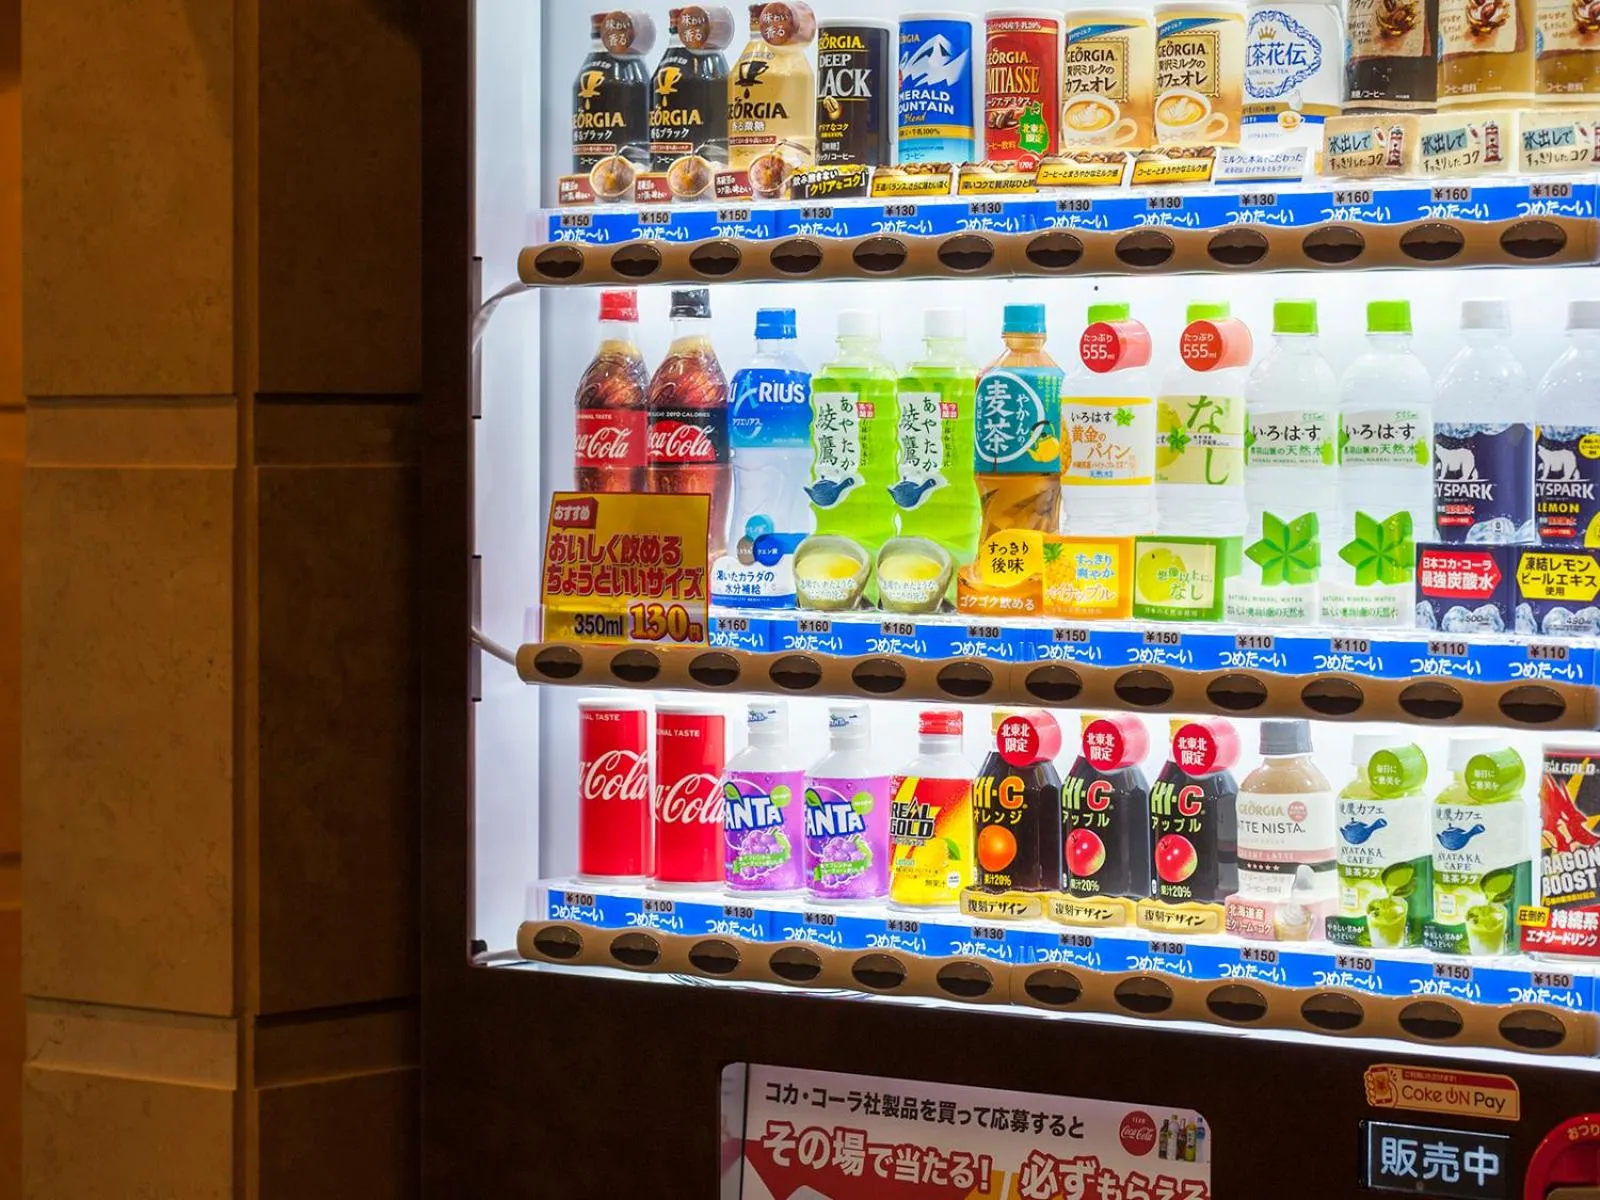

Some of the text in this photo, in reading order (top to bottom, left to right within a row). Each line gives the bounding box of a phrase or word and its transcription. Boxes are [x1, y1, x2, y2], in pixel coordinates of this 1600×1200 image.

[683, 28, 703, 41] 香る
[765, 26, 786, 37] 香る
[608, 35, 628, 46] 香る
[819, 55, 851, 67] DEEP
[1065, 78, 1117, 93] カフェオレ
[1157, 71, 1208, 88] カフェオレ
[1336, 191, 1370, 203] ¥160
[1434, 189, 1469, 200] ¥160
[1533, 185, 1568, 197] ¥160
[1059, 200, 1090, 211] ¥130
[1150, 197, 1181, 208] ¥130
[1242, 195, 1275, 206] ¥130
[719, 209, 748, 221] ¥150
[803, 207, 832, 219] ¥130
[886, 206, 915, 217] ¥130
[971, 203, 1001, 214] ¥130
[562, 214, 590, 226] ¥150
[641, 212, 669, 224] ¥150
[1083, 334, 1113, 343] たっぷり
[1183, 333, 1214, 342] たっぷり
[983, 380, 1009, 455] 麦茶
[839, 396, 855, 472] あやたか
[923, 396, 938, 472] あやたか
[1072, 425, 1107, 444] 黄金の
[1087, 441, 1131, 461] パイン
[554, 504, 590, 521] おすすめ
[1537, 503, 1580, 513] LEMON
[549, 534, 682, 565] おいしく飲める
[988, 542, 1029, 556] すっきり
[991, 557, 1024, 574] 後味
[1075, 554, 1112, 566] すっきり
[1422, 558, 1492, 572] 日本コカ・コーラ
[1525, 557, 1591, 572] 凍結レモン
[1076, 567, 1115, 579] 爽やか
[547, 566, 704, 600] ちょうどいいサイズ
[1422, 572, 1495, 590] 最強炭酸水
[725, 584, 761, 595] 水分補給
[1170, 584, 1204, 601] なし
[959, 595, 1035, 612] ゴクゴク飲める
[574, 614, 624, 636] 350ml
[718, 619, 747, 631] ¥160
[800, 621, 829, 632] ¥160
[883, 622, 913, 635] ¥160
[969, 628, 999, 638] ¥130
[1055, 630, 1087, 642] ¥150
[1146, 632, 1178, 644] ¥150
[1238, 636, 1271, 648] ¥110
[1334, 640, 1367, 653] ¥110
[1431, 642, 1465, 655] ¥110
[1530, 646, 1565, 659] ¥110
[1001, 724, 1029, 738] 北東北
[1005, 738, 1028, 753] 限定
[1087, 733, 1115, 748] 北東北
[1178, 737, 1207, 751] 北東北
[1090, 747, 1113, 761] 限定
[1181, 751, 1205, 766] 限定
[1063, 812, 1110, 828] アップル
[1151, 816, 1202, 832] アップル
[1262, 821, 1303, 834] NISTA
[984, 875, 1011, 886] 果汁20%
[1160, 885, 1192, 897] 果汁20%
[566, 894, 593, 906] ¥100
[644, 900, 673, 912] ¥100
[725, 906, 753, 918] ¥130
[968, 900, 1028, 916] 復刻デザイン
[1055, 902, 1113, 921] 復刻デザイン
[1228, 905, 1265, 921] 北海道産
[805, 913, 833, 925] ¥130
[1145, 909, 1206, 927] 復刻デザイン
[1518, 909, 1599, 929] 圧倒的 持続系
[888, 919, 918, 932] ¥130
[974, 927, 1004, 939] ¥130
[1526, 930, 1598, 948] エナジードリンク
[1061, 934, 1092, 947] ¥130
[1151, 941, 1184, 954] ¥130
[1243, 948, 1276, 962] ¥150
[1338, 957, 1372, 971] ¥150
[1436, 965, 1470, 979] ¥150
[1534, 973, 1569, 987] ¥150
[1402, 1085, 1506, 1112] Coke ON Pay
[765, 1082, 1085, 1139] コカ・コーラ社製品を買って応募すると
[1381, 1136, 1499, 1186] 販売中
